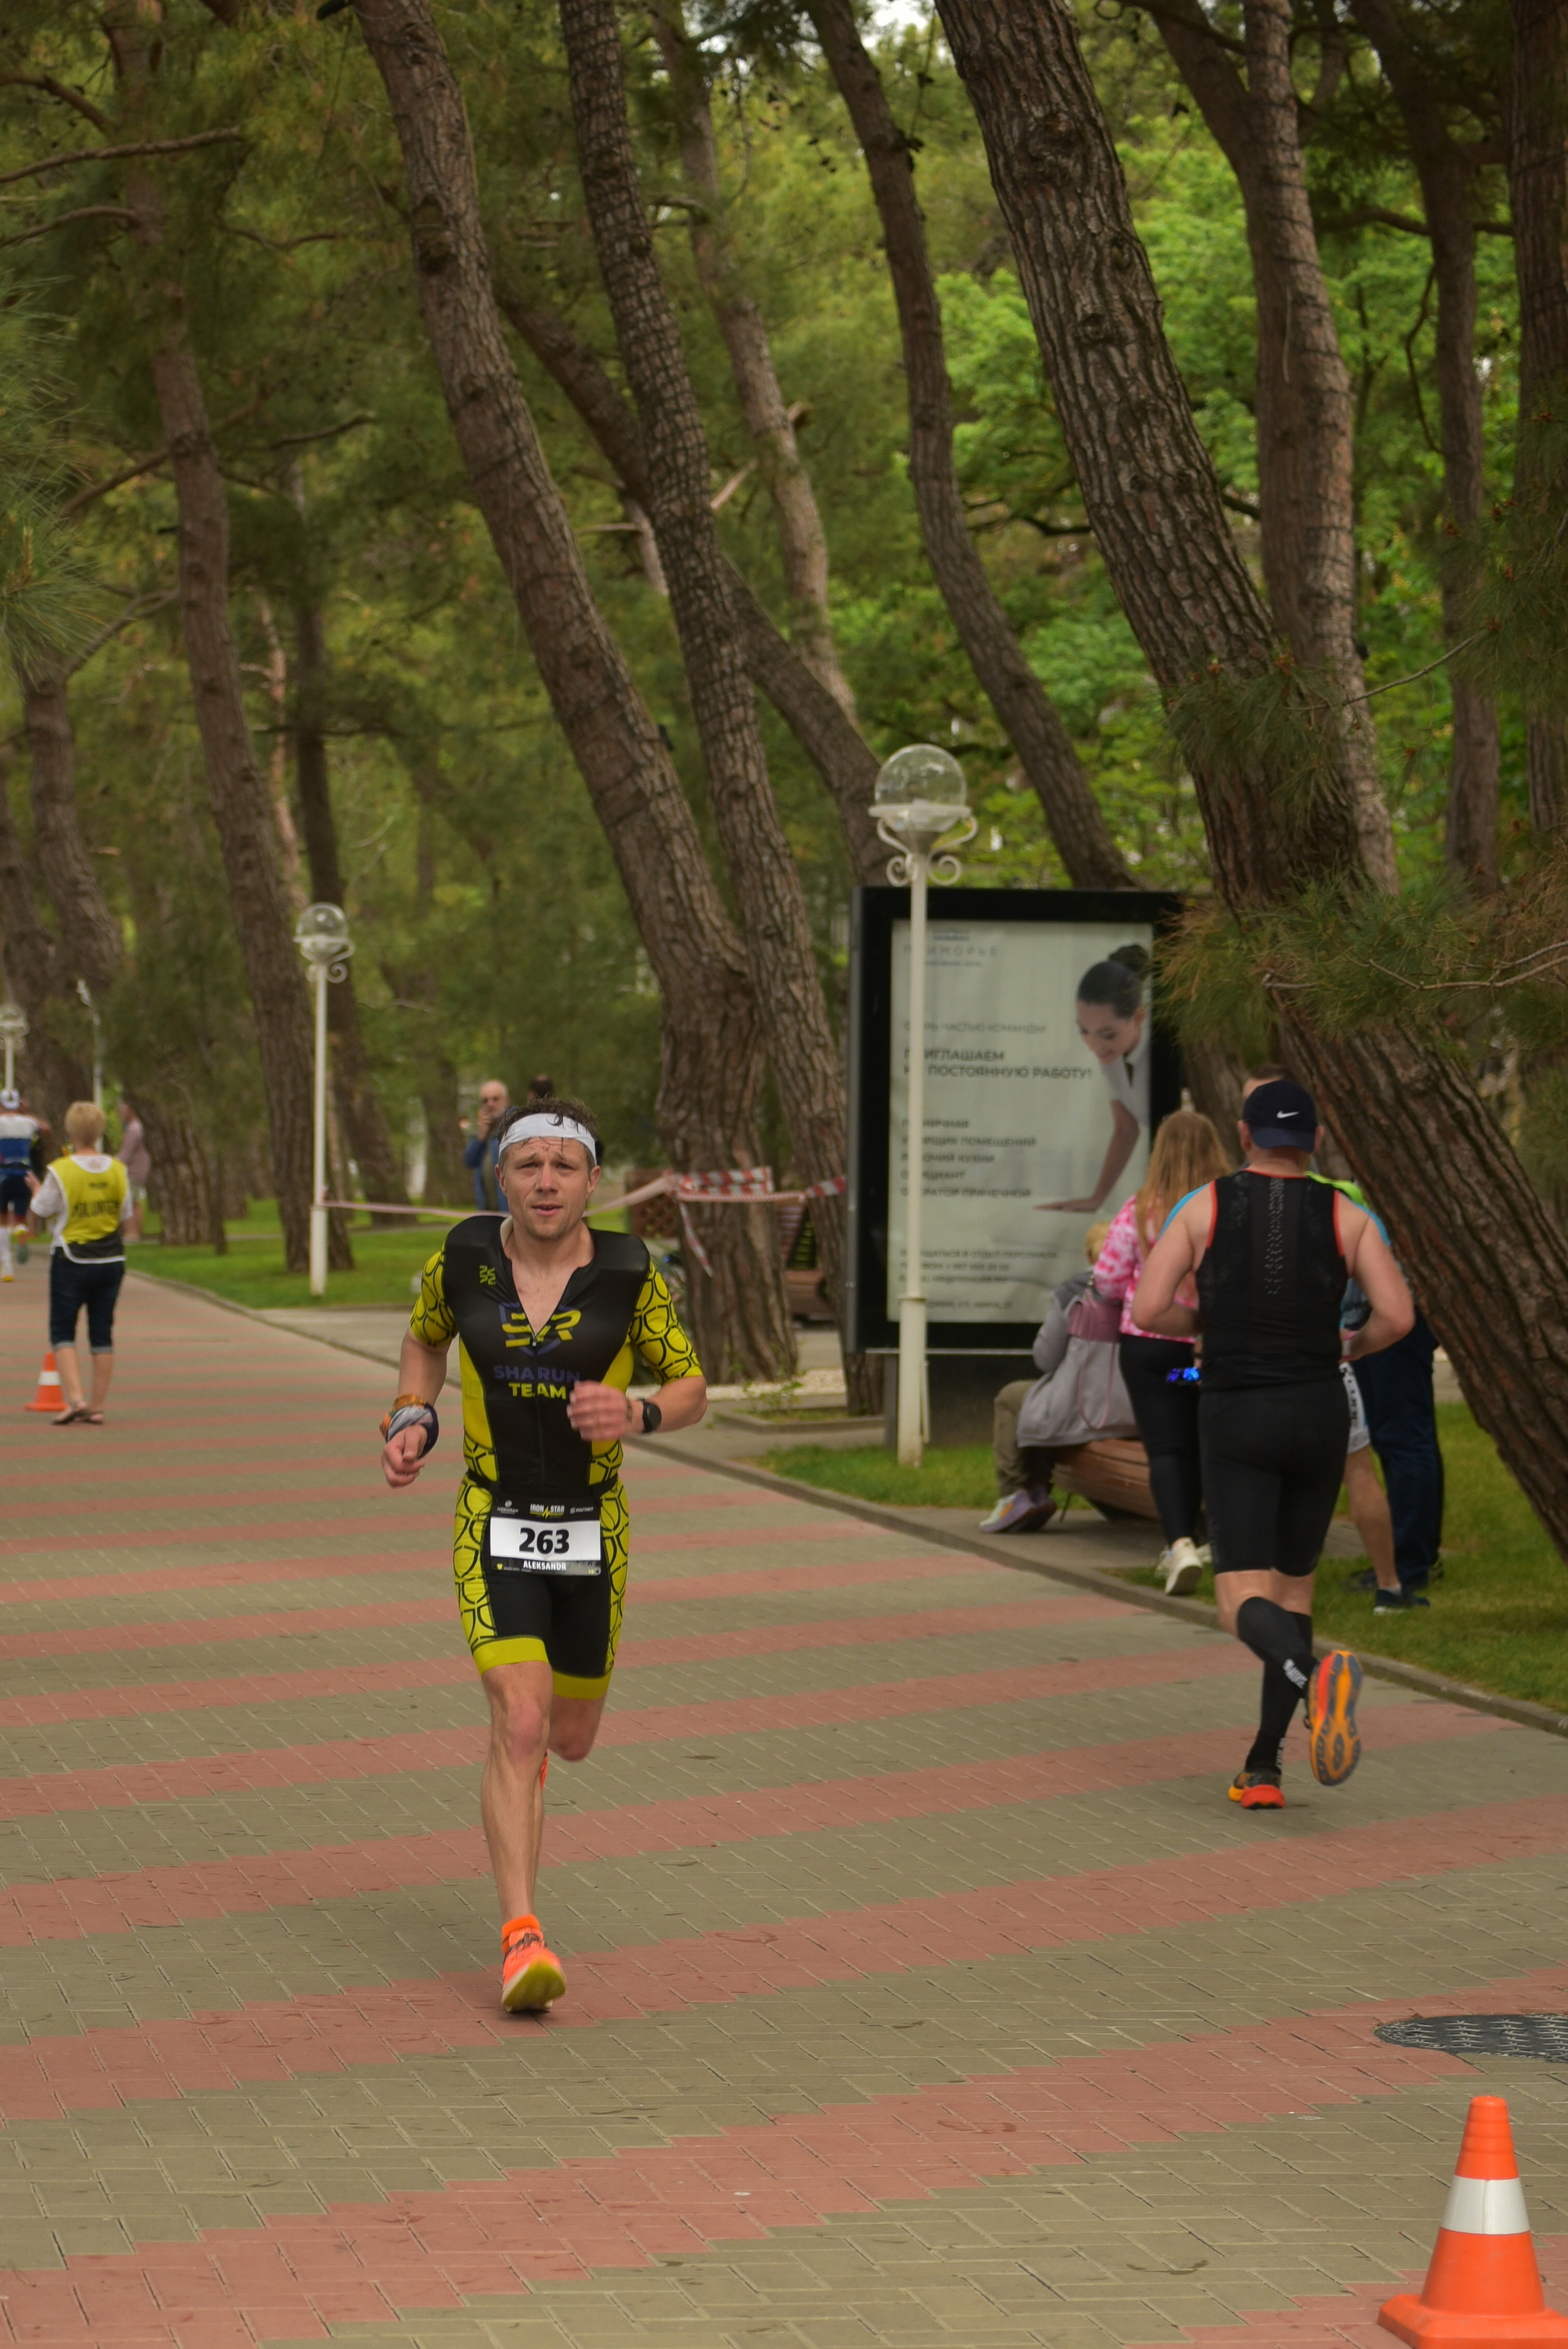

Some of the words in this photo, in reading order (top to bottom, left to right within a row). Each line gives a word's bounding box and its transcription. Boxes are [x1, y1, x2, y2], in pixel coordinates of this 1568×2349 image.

[928, 1065, 1028, 1078] ПОСТОЯННУЮ
[1032, 1067, 1092, 1080] РАБОТУ!
[508, 1382, 567, 1400] TEAM
[530, 1503, 545, 1513] IRON
[550, 1505, 565, 1515] STAR
[519, 1527, 570, 1554] 263
[522, 1560, 567, 1571] ALEKSANDR
